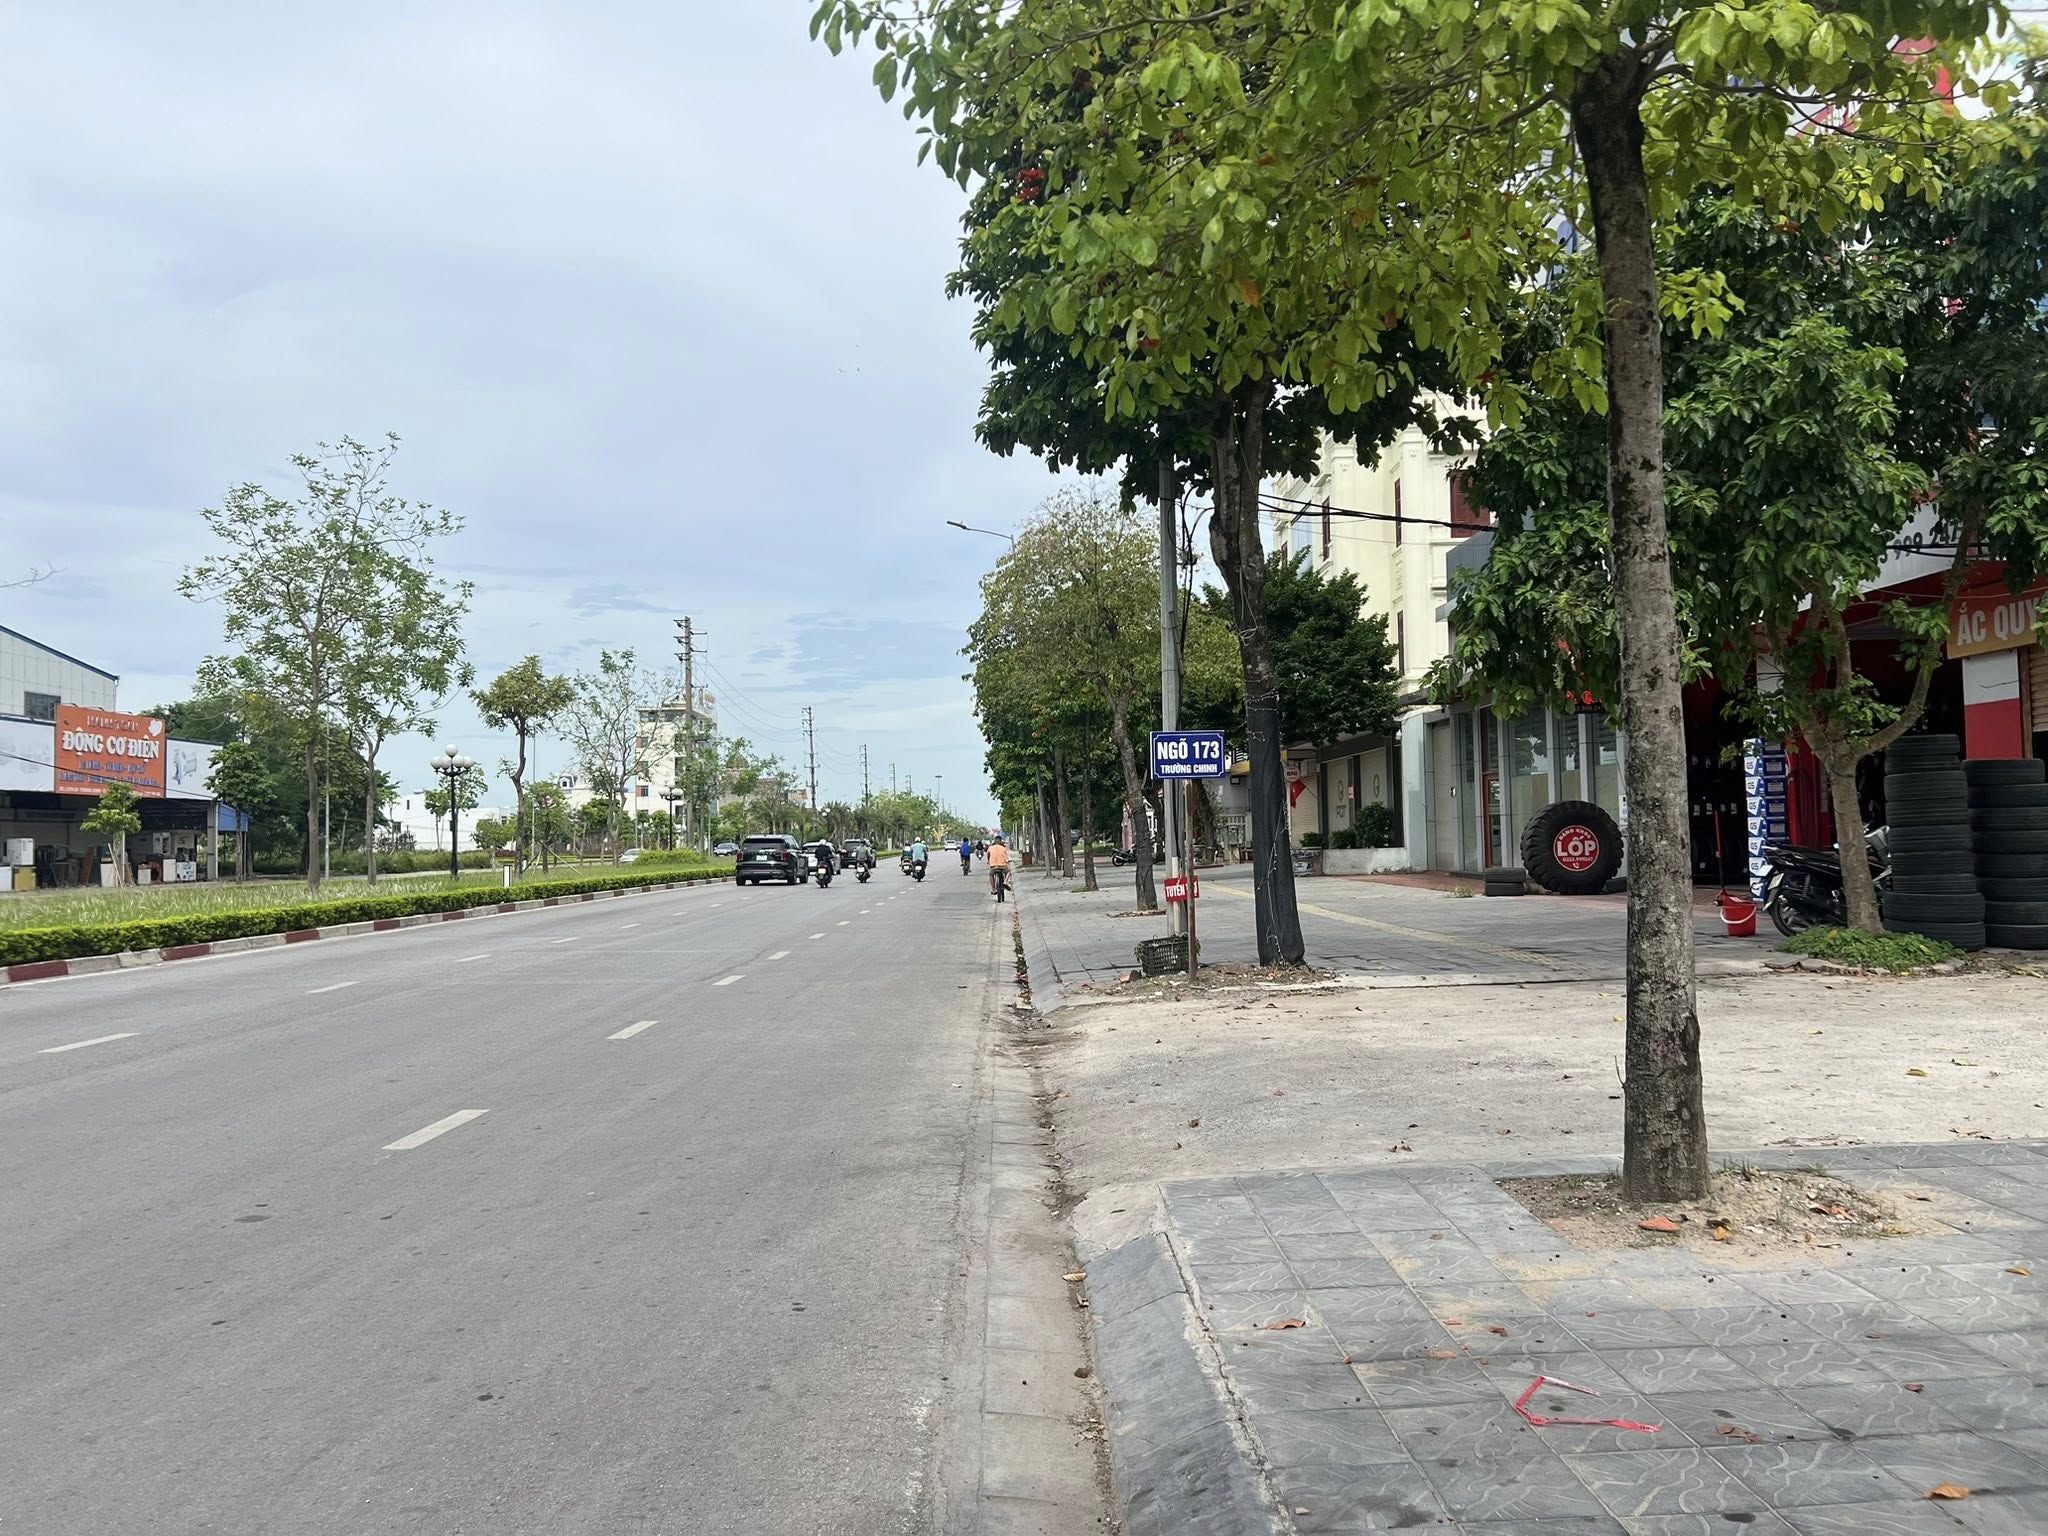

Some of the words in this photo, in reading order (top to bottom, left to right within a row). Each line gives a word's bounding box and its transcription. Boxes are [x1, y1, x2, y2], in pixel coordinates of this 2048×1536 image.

[1957, 601, 1987, 646] ẮC
[62, 726, 104, 757] ĐỘNG
[106, 735, 127, 756] CƠ
[127, 734, 160, 763] ĐIỆN
[1157, 738, 1188, 760] NGÕ
[1192, 740, 1220, 759] 173
[1160, 762, 1192, 774] TRƯỜNG
[1193, 764, 1218, 773] CHINH
[1557, 836, 1596, 857] LỐP
